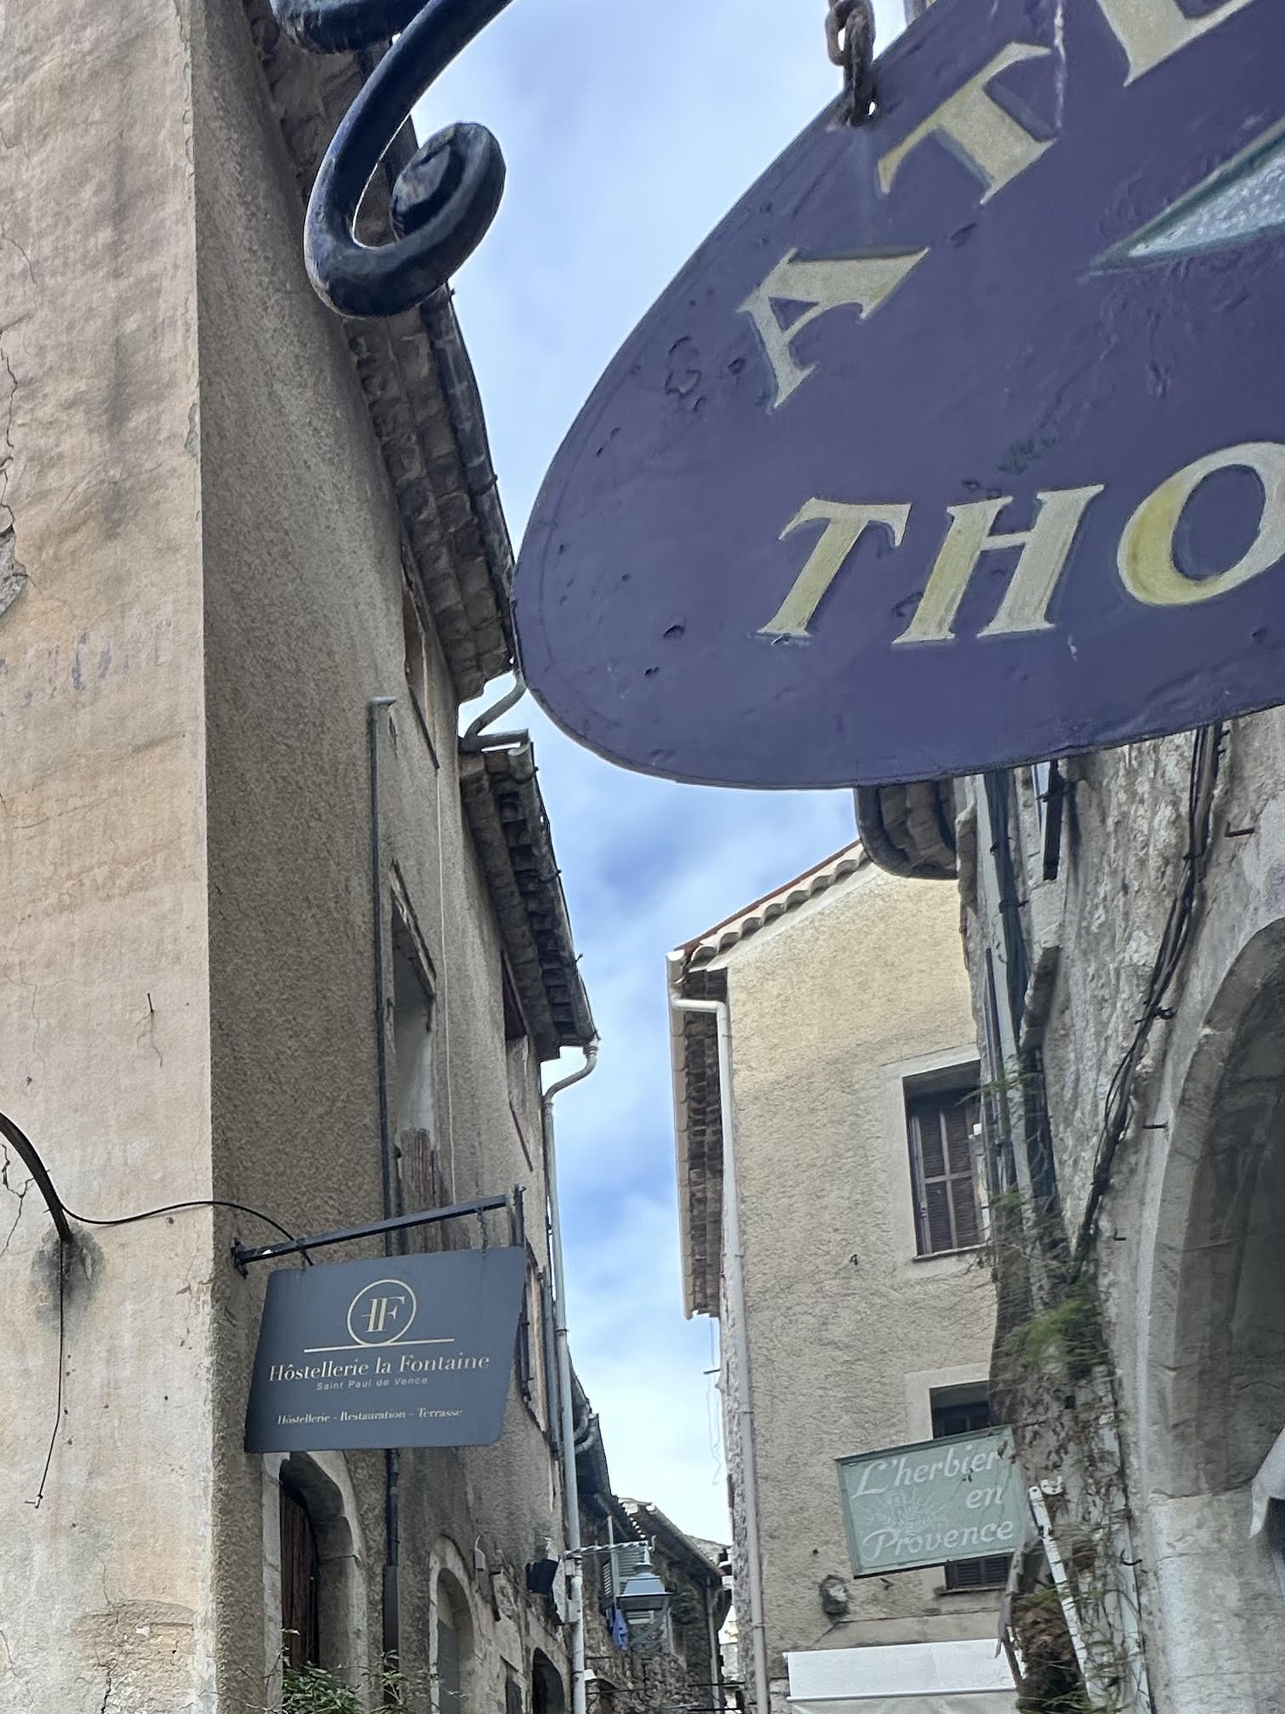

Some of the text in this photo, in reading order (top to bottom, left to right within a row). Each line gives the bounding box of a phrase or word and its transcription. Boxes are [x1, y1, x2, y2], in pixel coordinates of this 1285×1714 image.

[268, 1351, 491, 1382] Hôstellerie la Fontaine
[316, 1376, 429, 1391] Saint Paul de Vence
[340, 1410, 407, 1422] Restauration
[417, 1407, 464, 1419] Terrasse
[849, 1444, 1001, 1500] L'herbier
[966, 1487, 1004, 1510] en
[862, 1520, 1014, 1562] Provence
